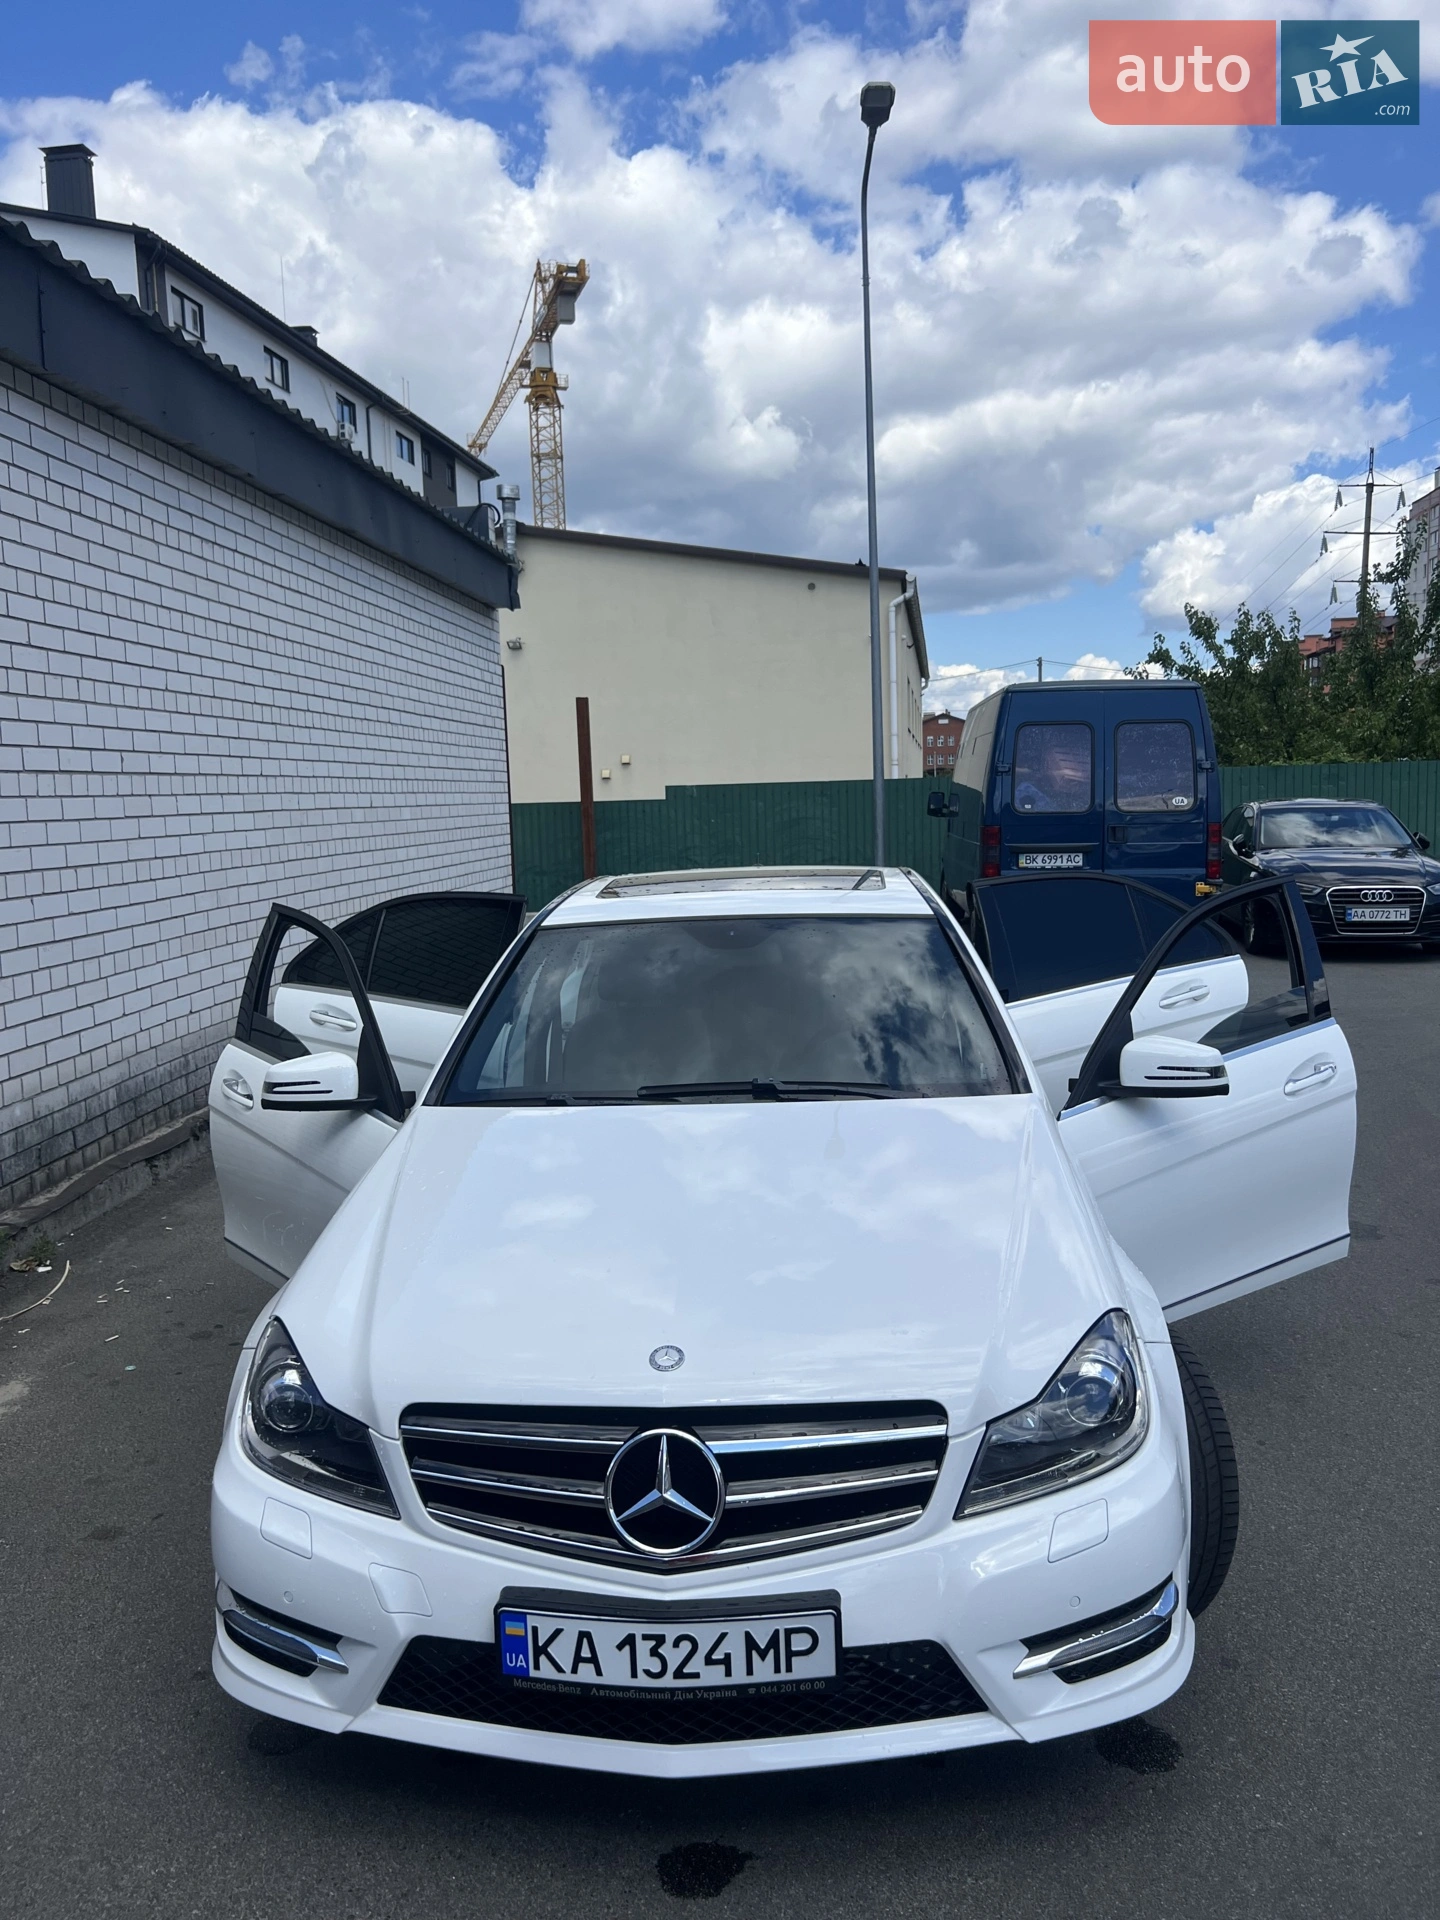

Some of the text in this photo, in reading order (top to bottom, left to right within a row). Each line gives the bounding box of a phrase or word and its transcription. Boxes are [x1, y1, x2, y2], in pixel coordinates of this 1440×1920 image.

[1024, 854, 1081, 865] BK 6991 AC
[1352, 910, 1407, 919] AA 0772 TH
[506, 1652, 527, 1668] UA
[531, 1625, 820, 1680] KA 1324 MP
[673, 1690, 694, 1700] Дім
[696, 1689, 738, 1700] Україна
[760, 1684, 778, 1694] 044
[780, 1683, 797, 1693] 201
[799, 1682, 812, 1691] 60
[813, 1680, 826, 1690] 00
